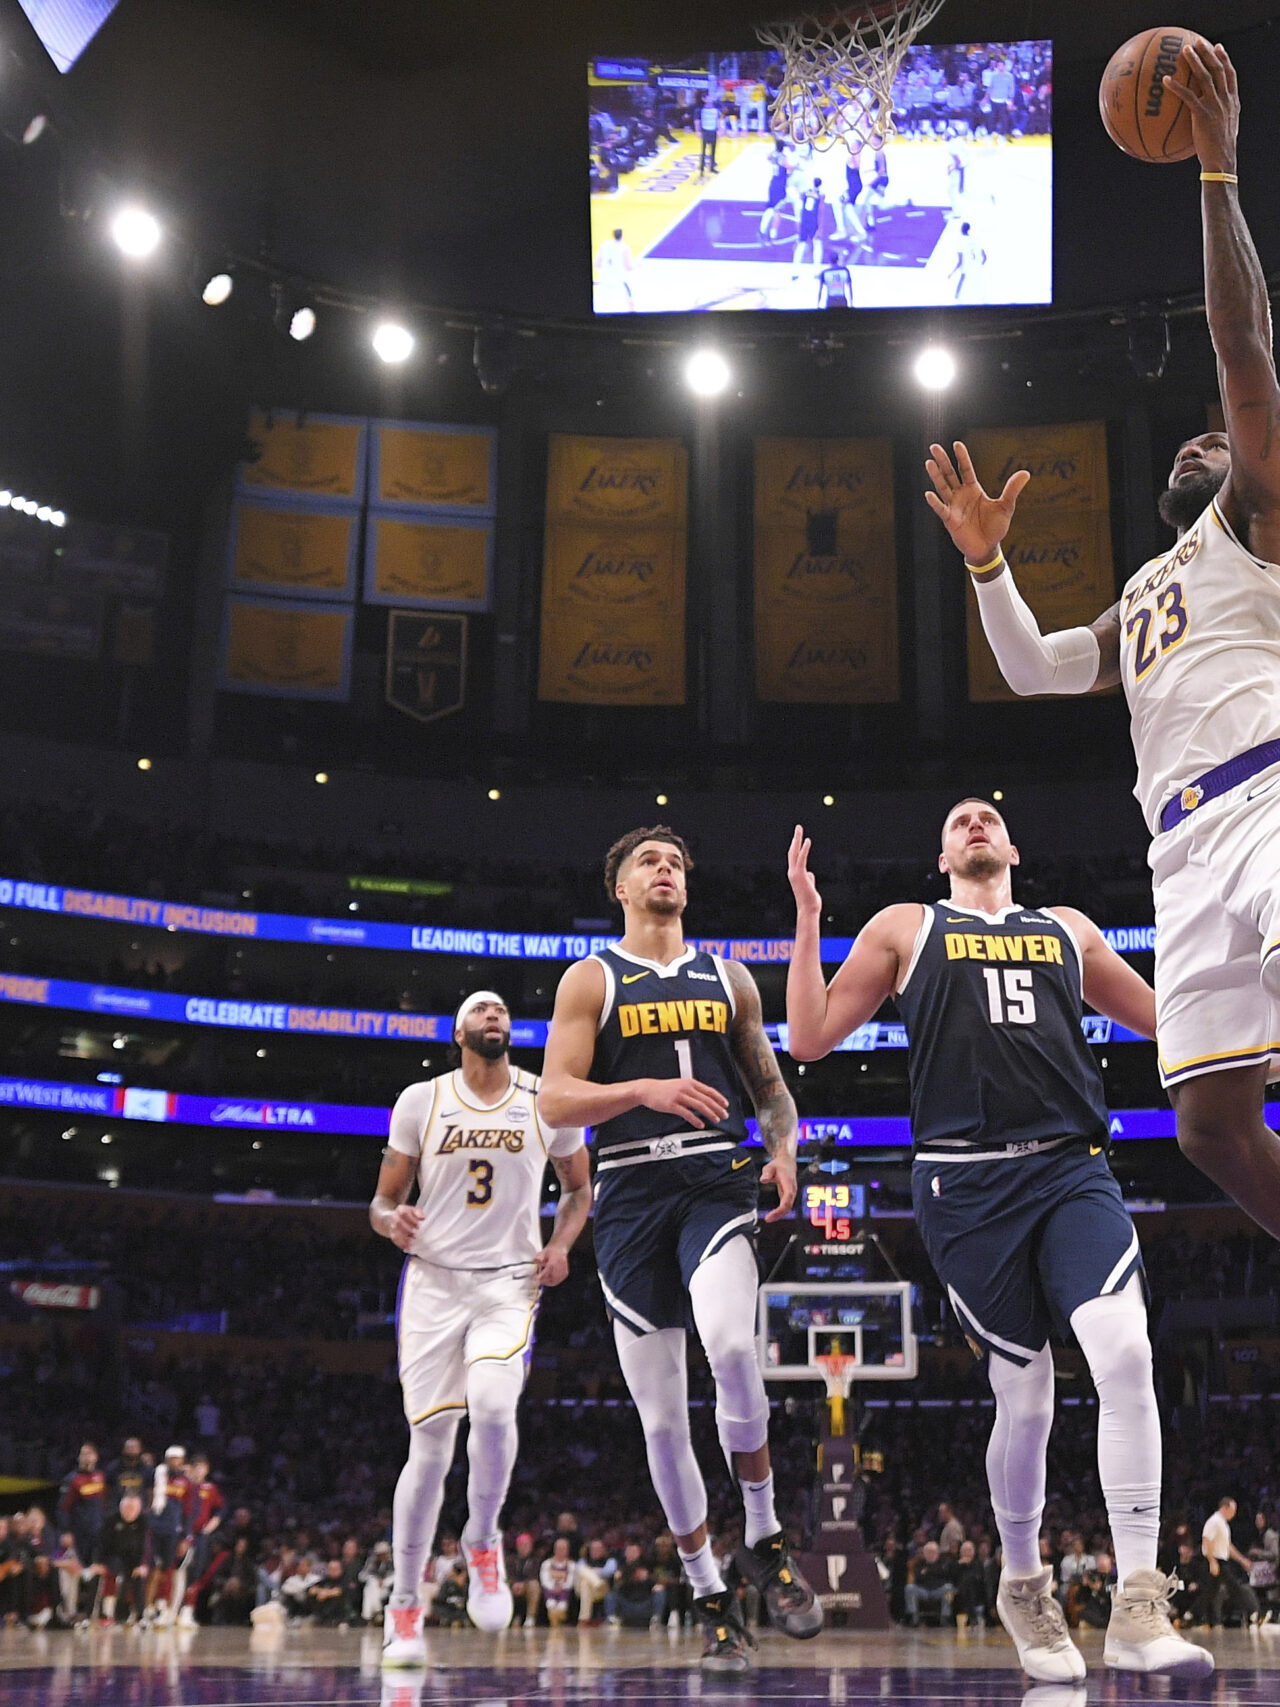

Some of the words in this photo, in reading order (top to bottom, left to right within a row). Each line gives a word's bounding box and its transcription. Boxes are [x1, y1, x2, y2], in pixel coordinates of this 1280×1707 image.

[1144, 35, 1185, 118] Wilson
[1126, 580, 1191, 684] 23
[15, 880, 63, 912] FULL
[63, 890, 161, 927] DISABILITY
[164, 903, 258, 936] INCLUSION
[411, 927, 485, 955] LEADING
[488, 932, 520, 955] THE
[522, 935, 560, 957] WAY
[563, 937, 587, 958] TO
[944, 933, 1064, 966] DENVER
[982, 967, 1037, 1024] 15
[186, 998, 287, 1030] CELEBRATE
[288, 1007, 384, 1037] DISABILITY
[387, 1012, 438, 1039] PRIDE
[618, 1000, 728, 1038] DENVER
[674, 1039, 693, 1080] 1
[436, 1125, 525, 1157] LAKERS
[465, 1159, 495, 1210] 3
[806, 1185, 850, 1209] 34.3
[810, 1206, 851, 1241] 4.5
